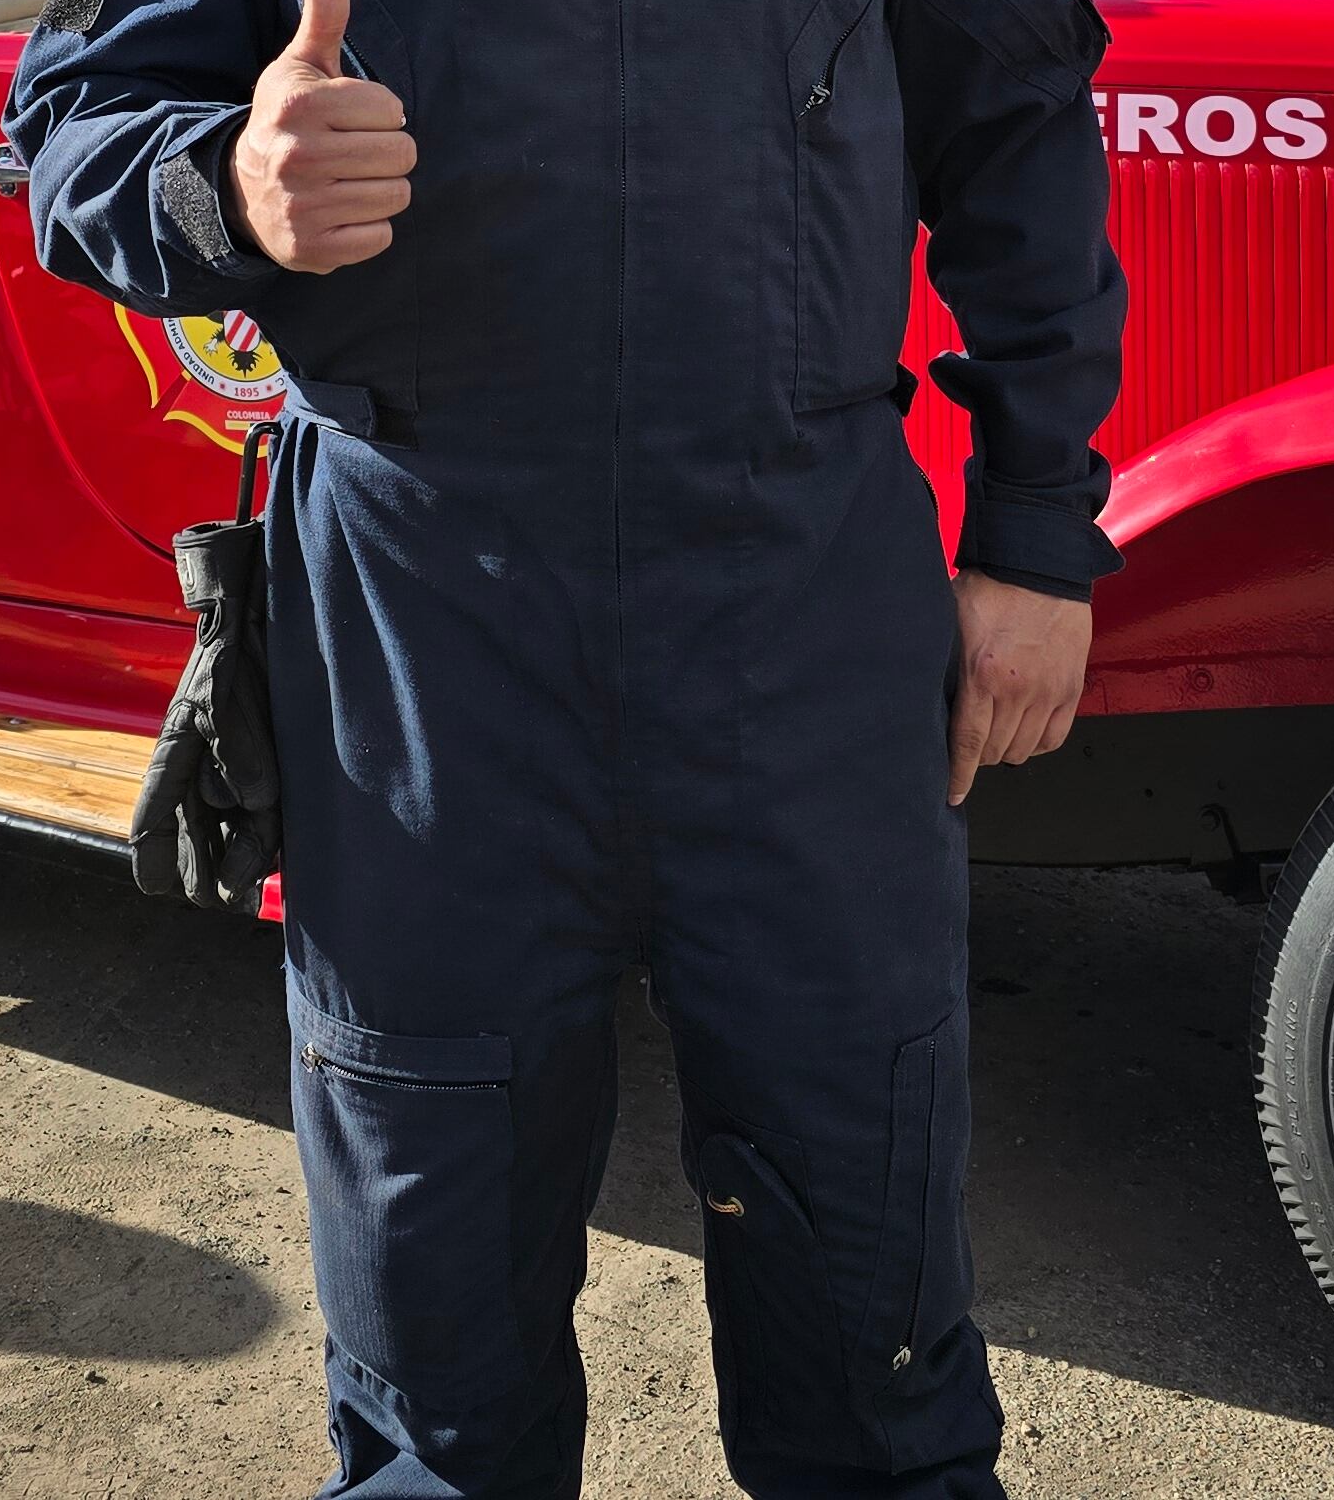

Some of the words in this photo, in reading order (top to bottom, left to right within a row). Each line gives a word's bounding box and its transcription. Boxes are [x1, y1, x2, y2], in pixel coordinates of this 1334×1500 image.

[183, 351, 215, 386] UNIDAD
[234, 386, 260, 399] 1895
[226, 409, 272, 421] COLOMBIA
